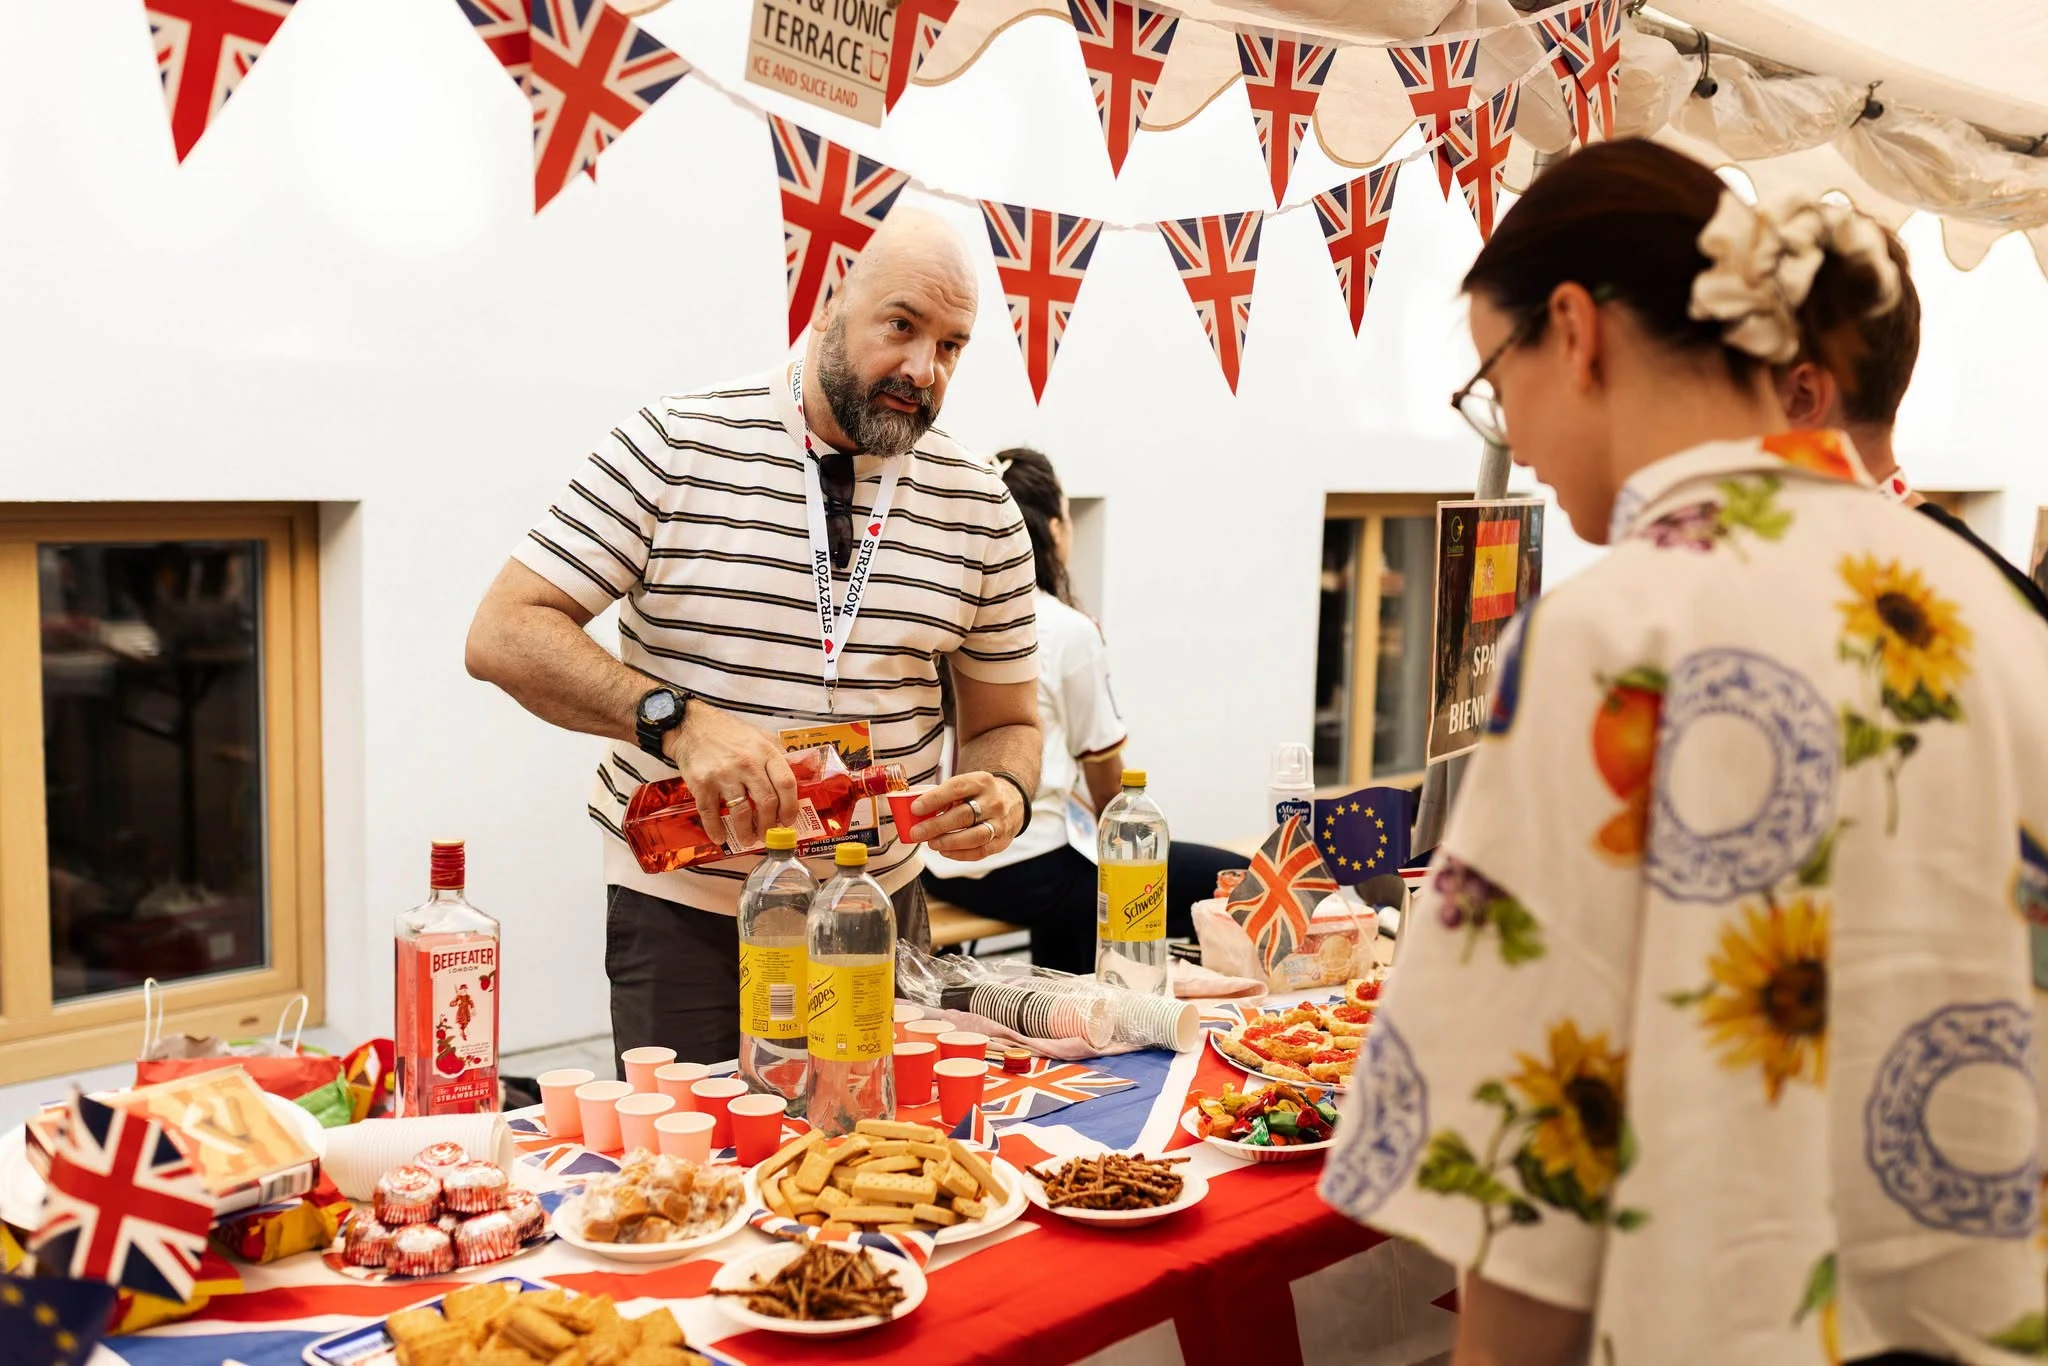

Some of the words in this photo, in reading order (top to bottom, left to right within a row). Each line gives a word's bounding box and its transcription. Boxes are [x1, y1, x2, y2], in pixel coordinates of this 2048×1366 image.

[762, 3, 864, 74] TERRACE
[832, 0, 893, 42] TONIC
[753, 56, 770, 77] ICE
[772, 63, 798, 87] AND
[800, 72, 827, 98] SLICE
[829, 86, 859, 109] LAND
[815, 549, 833, 635] STRZYŻÓW
[842, 539, 875, 618] STRZYŻÓW
[1472, 643, 1497, 678] SPA
[809, 837, 831, 846] UNITED
[831, 834, 859, 843] KINGDOM
[433, 947, 494, 973] BEEFEATER
[448, 965, 479, 974] LONDON
[436, 1088, 489, 1103] STRAWBERRY
[453, 1083, 473, 1093] PINK
